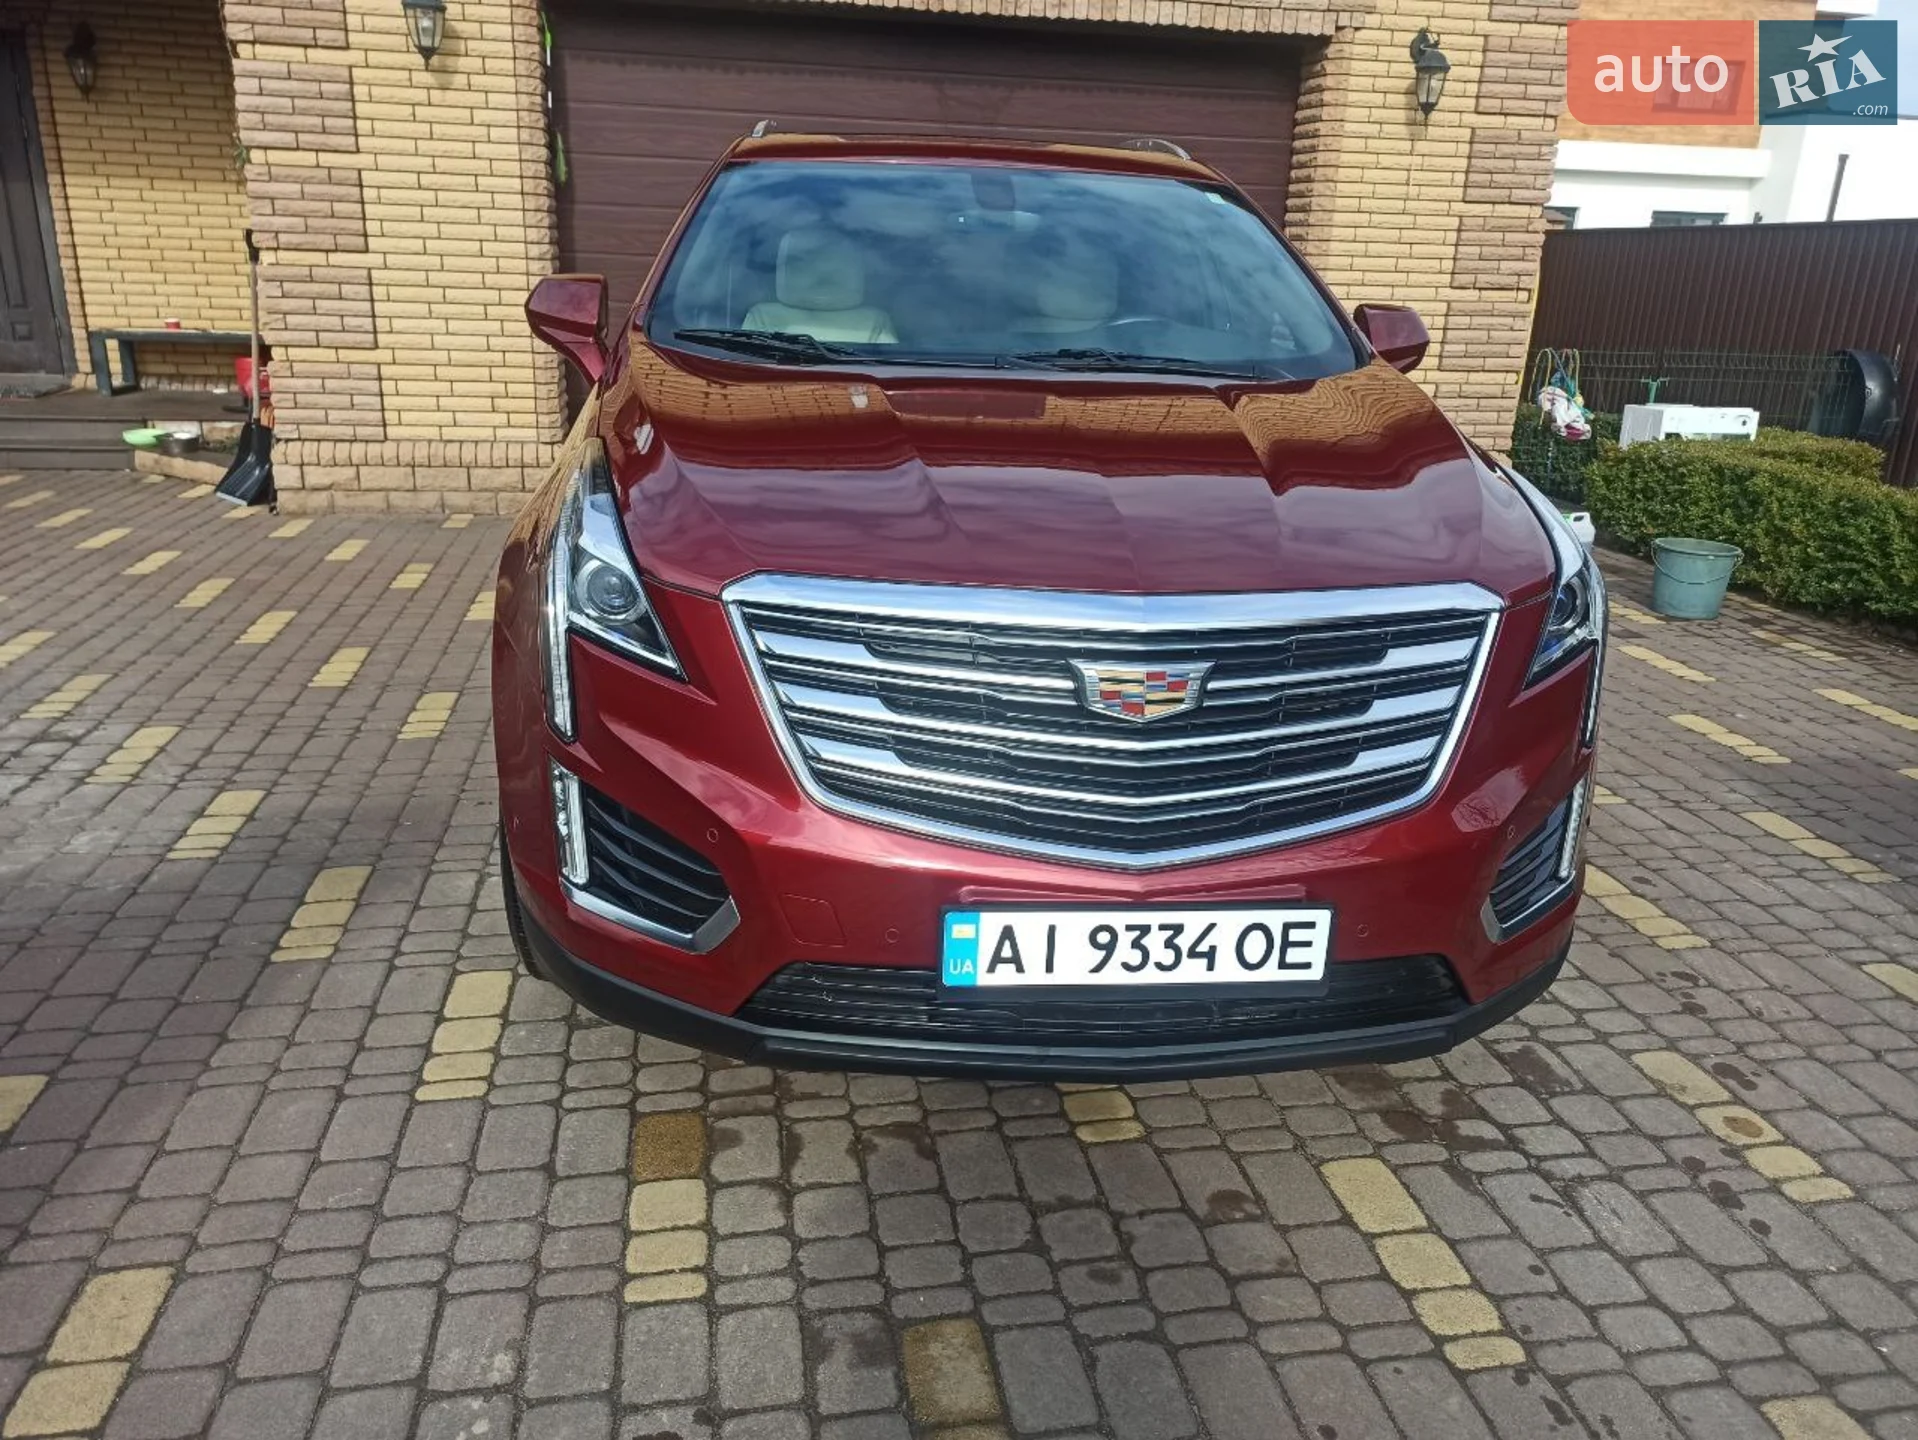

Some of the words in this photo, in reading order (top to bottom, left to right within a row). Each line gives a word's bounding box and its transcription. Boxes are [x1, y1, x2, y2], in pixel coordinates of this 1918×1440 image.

[985, 924, 1056, 974] AI
[1088, 922, 1218, 974] 9334
[1235, 920, 1317, 972] OE
[949, 958, 975, 975] UA
